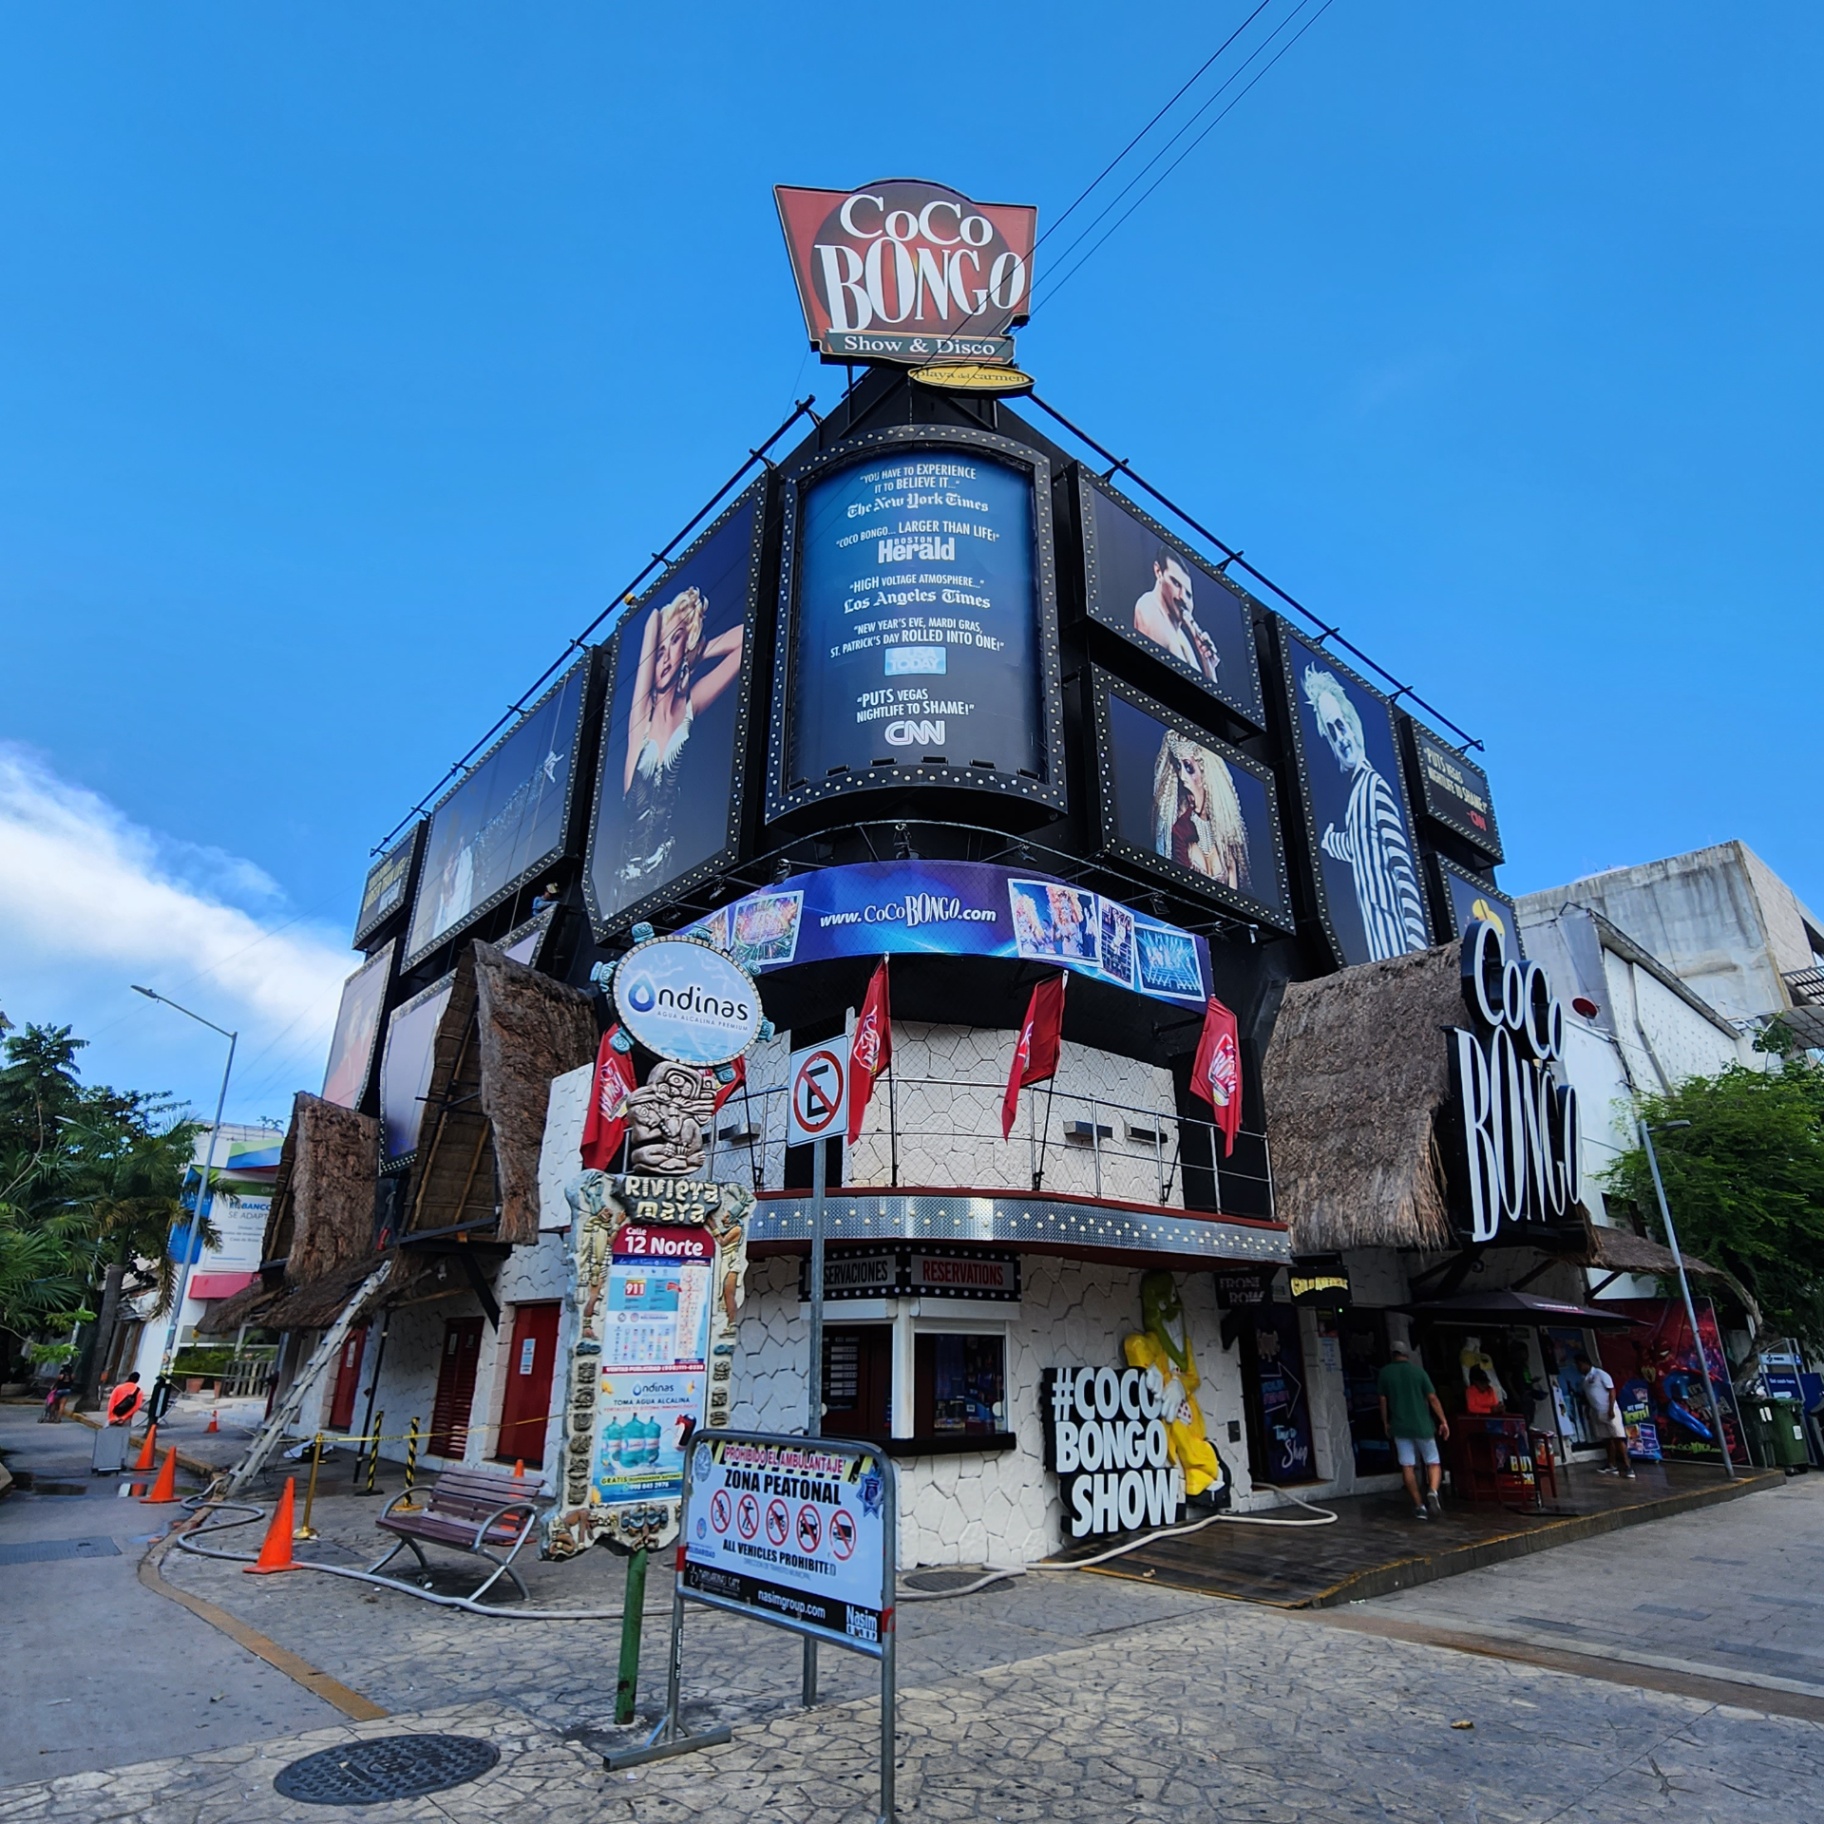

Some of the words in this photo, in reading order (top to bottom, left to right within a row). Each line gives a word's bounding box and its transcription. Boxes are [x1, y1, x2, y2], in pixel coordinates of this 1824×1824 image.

[814, 237, 1025, 333] BONGO
[844, 336, 902, 352] Show
[909, 338, 929, 352] &
[936, 339, 995, 355] Disco
[973, 373, 1025, 383] carmen
[882, 469, 901, 479] HAVE
[904, 467, 914, 476] TO
[916, 464, 976, 479] EXPERIENCE
[874, 484, 882, 494] IT
[884, 483, 894, 492] TO
[896, 477, 936, 490] BELIEVE
[847, 504, 872, 518] The
[873, 497, 904, 512] New
[907, 493, 943, 509] York
[945, 493, 988, 512] Times
[898, 521, 939, 534] LARGER
[943, 521, 970, 535] THAN
[878, 537, 955, 563] Herald
[894, 536, 932, 545] BOSTON
[881, 574, 917, 586] VOLTAGE
[844, 598, 870, 614] Los
[873, 588, 936, 607] Angeles
[941, 589, 991, 609] Times
[878, 618, 906, 631] YEAR'S
[909, 617, 926, 629] EVE,
[928, 617, 956, 628] MARDI
[958, 619, 983, 634] GRAS,
[830, 647, 841, 658] ST.
[842, 636, 881, 653] PATRICK'S
[883, 633, 900, 644] DAY
[902, 630, 943, 642] ROLLED
[946, 630, 972, 645] INTO
[889, 658, 940, 671] TODAY
[897, 688, 928, 701] VEGAS
[856, 703, 904, 723] NIGHTLIFE
[906, 703, 920, 715] TO
[884, 720, 945, 746] CNN
[657, 1011, 678, 1019] AGUA
[681, 1015, 715, 1025] ALCALINA
[718, 1021, 748, 1031] PREMIUM
[1454, 1024, 1582, 1242] BONGO
[625, 1227, 647, 1236] Calle
[624, 1236, 647, 1254] 12
[650, 1237, 704, 1256] Norte
[824, 1260, 888, 1285] SERVACIONES
[923, 1260, 1004, 1285] RESERVATIONS
[1219, 1276, 1261, 1289] FRONT
[625, 1283, 645, 1294] 911
[1229, 1291, 1265, 1303] ROW
[1056, 1419, 1168, 1473] BONGO
[725, 1446, 766, 1467] PROHIBIDO
[768, 1450, 779, 1465] EL
[779, 1452, 843, 1474] AMBULANTAJE
[602, 1476, 627, 1484] GRATIS
[724, 1469, 760, 1492] ZONA
[763, 1473, 842, 1505] PEATONAL
[1071, 1468, 1179, 1537] SHOW
[722, 1538, 736, 1553] ALL
[737, 1542, 778, 1562] VEHICLES
[779, 1552, 837, 1576] PROHIBITED
[758, 1589, 826, 1619] nasimgroup.com
[846, 1605, 877, 1631] Nasim
